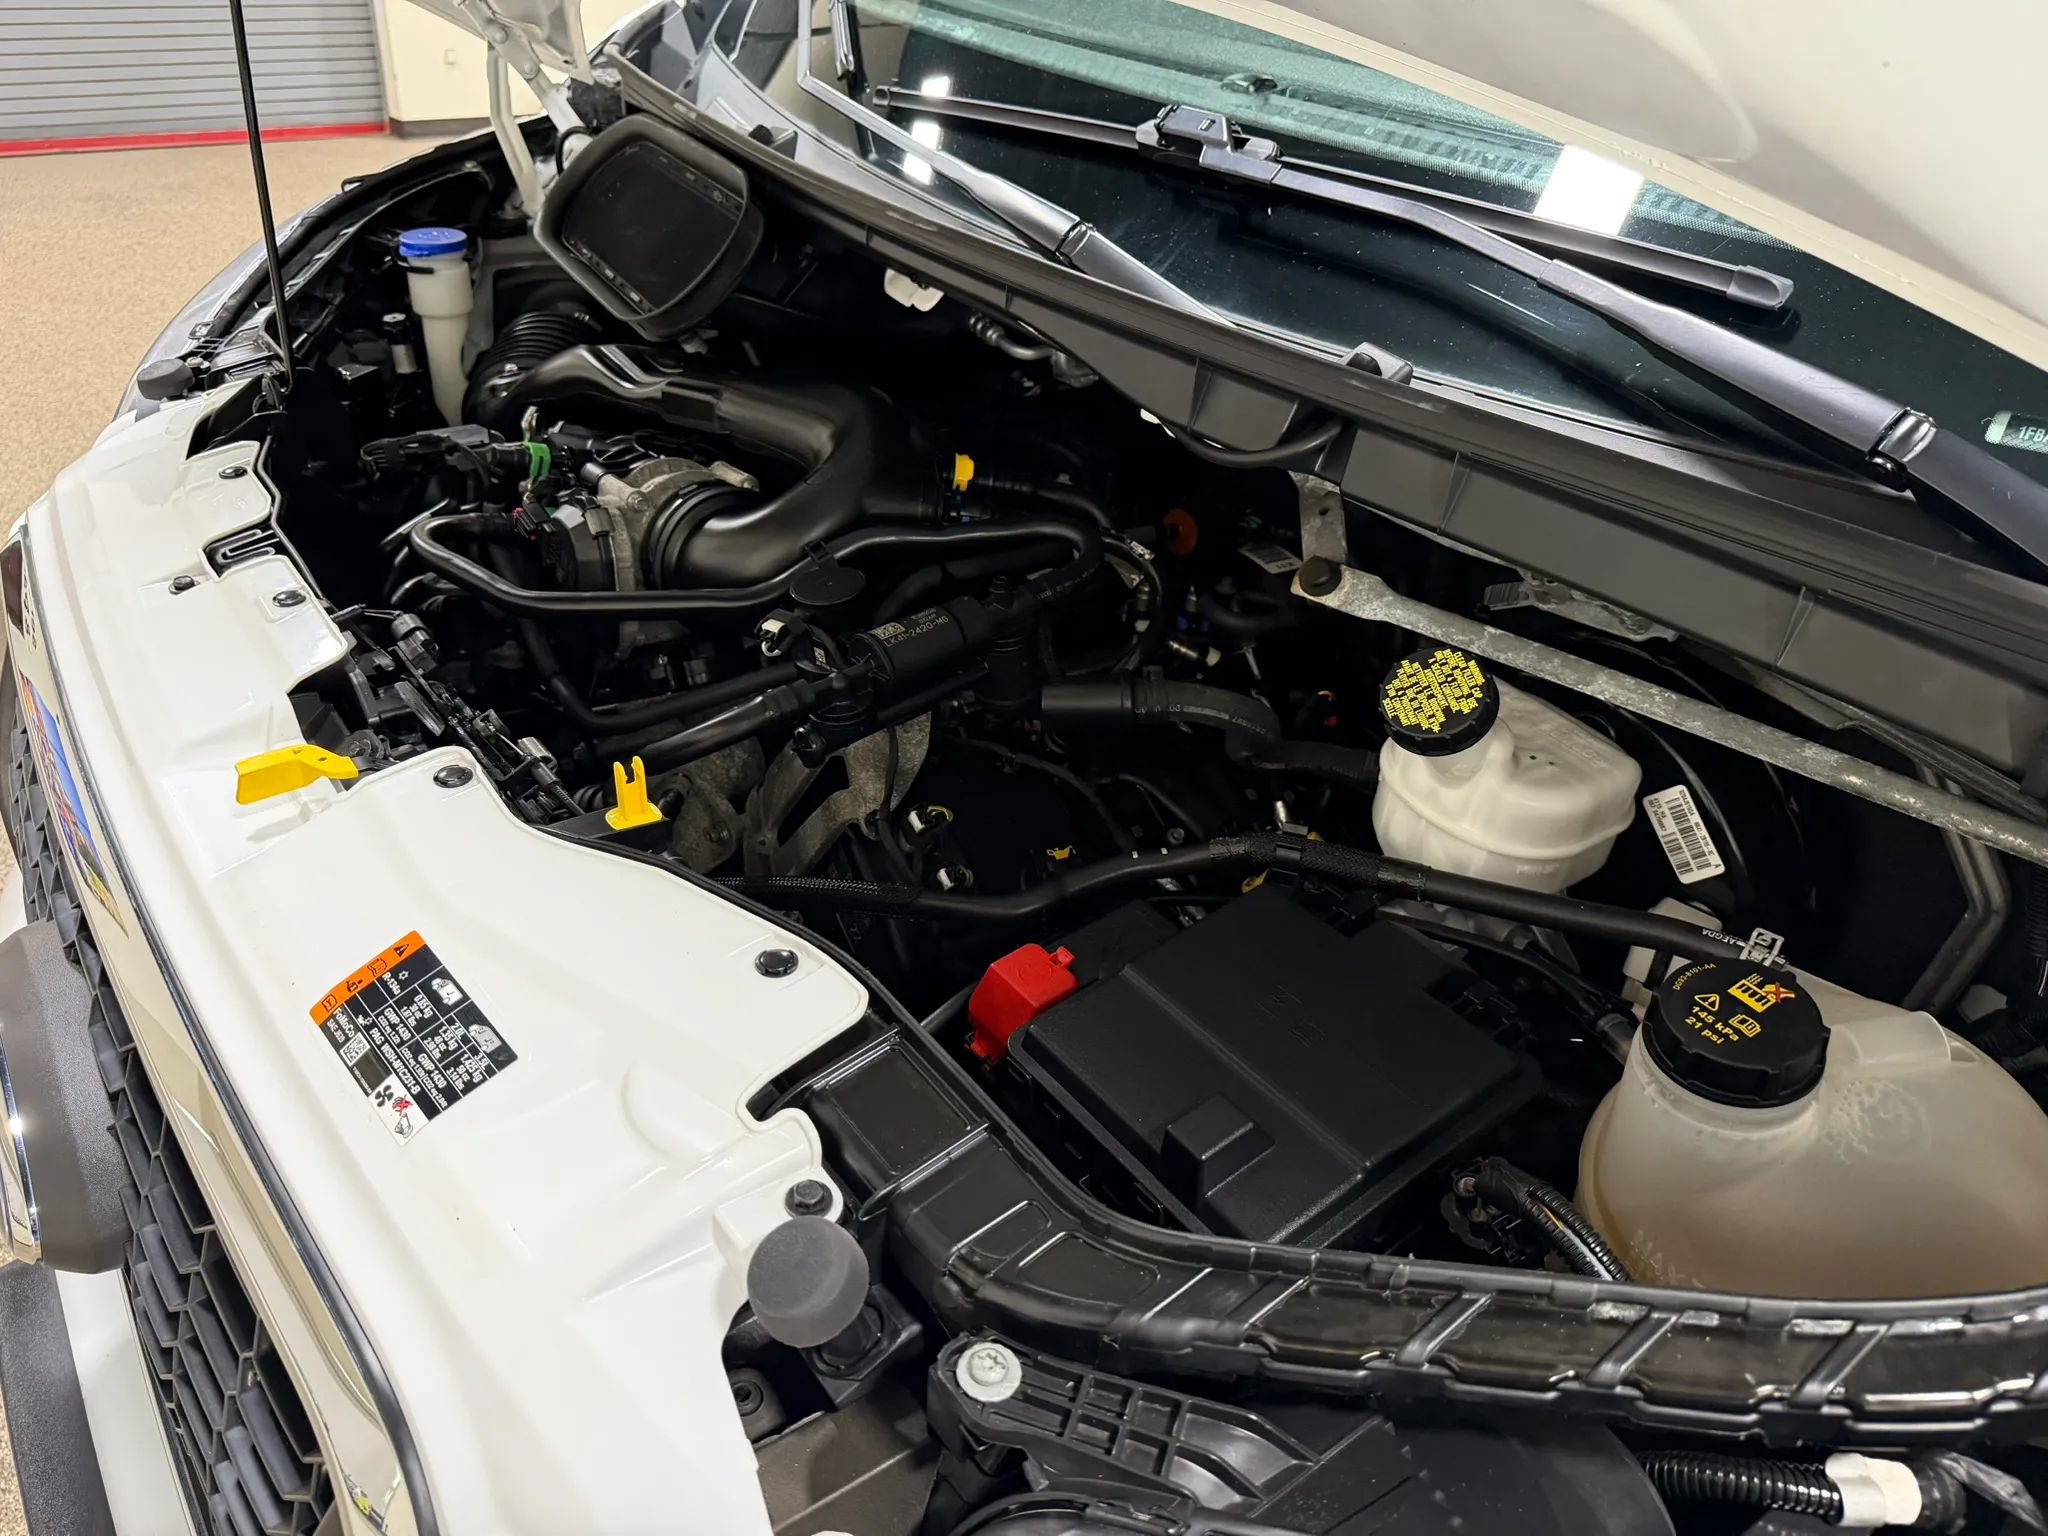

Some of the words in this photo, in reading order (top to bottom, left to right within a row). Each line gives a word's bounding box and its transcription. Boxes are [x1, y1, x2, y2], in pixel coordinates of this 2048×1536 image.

[1431, 663, 1446, 683] SEALED
[1453, 651, 1467, 669] CLEAN
[1462, 668, 1477, 687] FILLER
[1472, 687, 1483, 698] CAP
[1441, 664, 1452, 676] DOT
[1450, 681, 1463, 698] FLUID
[1457, 697, 1471, 714] FROM
[1467, 697, 1479, 710] USE
[382, 972, 402, 995] R-134a
[378, 1016, 389, 1027] CO2
[408, 1016, 418, 1027] lbs
[423, 1006, 435, 1019] kg
[327, 1019, 339, 1032] SAE
[333, 1008, 357, 1038] FoMoCo
[384, 1007, 401, 1026] GWP
[396, 1023, 412, 1041] 1430
[450, 1023, 466, 1039] 2.0L
[1684, 1017, 1701, 1029] 21
[1701, 1029, 1725, 1045] psi
[1690, 1006, 1714, 1024] 145
[1714, 1022, 1740, 1042] kPa
[439, 1025, 454, 1041] 1.35
[448, 1038, 460, 1051] kg
[369, 1028, 385, 1045] PAG
[381, 1043, 421, 1095] WSH-M1C231-B
[402, 1048, 413, 1060] CO2
[432, 1048, 443, 1059] lbs
[474, 1052, 490, 1070] 3.5L
[417, 1053, 435, 1072] GWP
[430, 1070, 447, 1089] 1430
[460, 1054, 478, 1073] 1.425
[472, 1070, 485, 1084] kg
[423, 1077, 435, 1090] CO2
[455, 1078, 466, 1090] lbs
